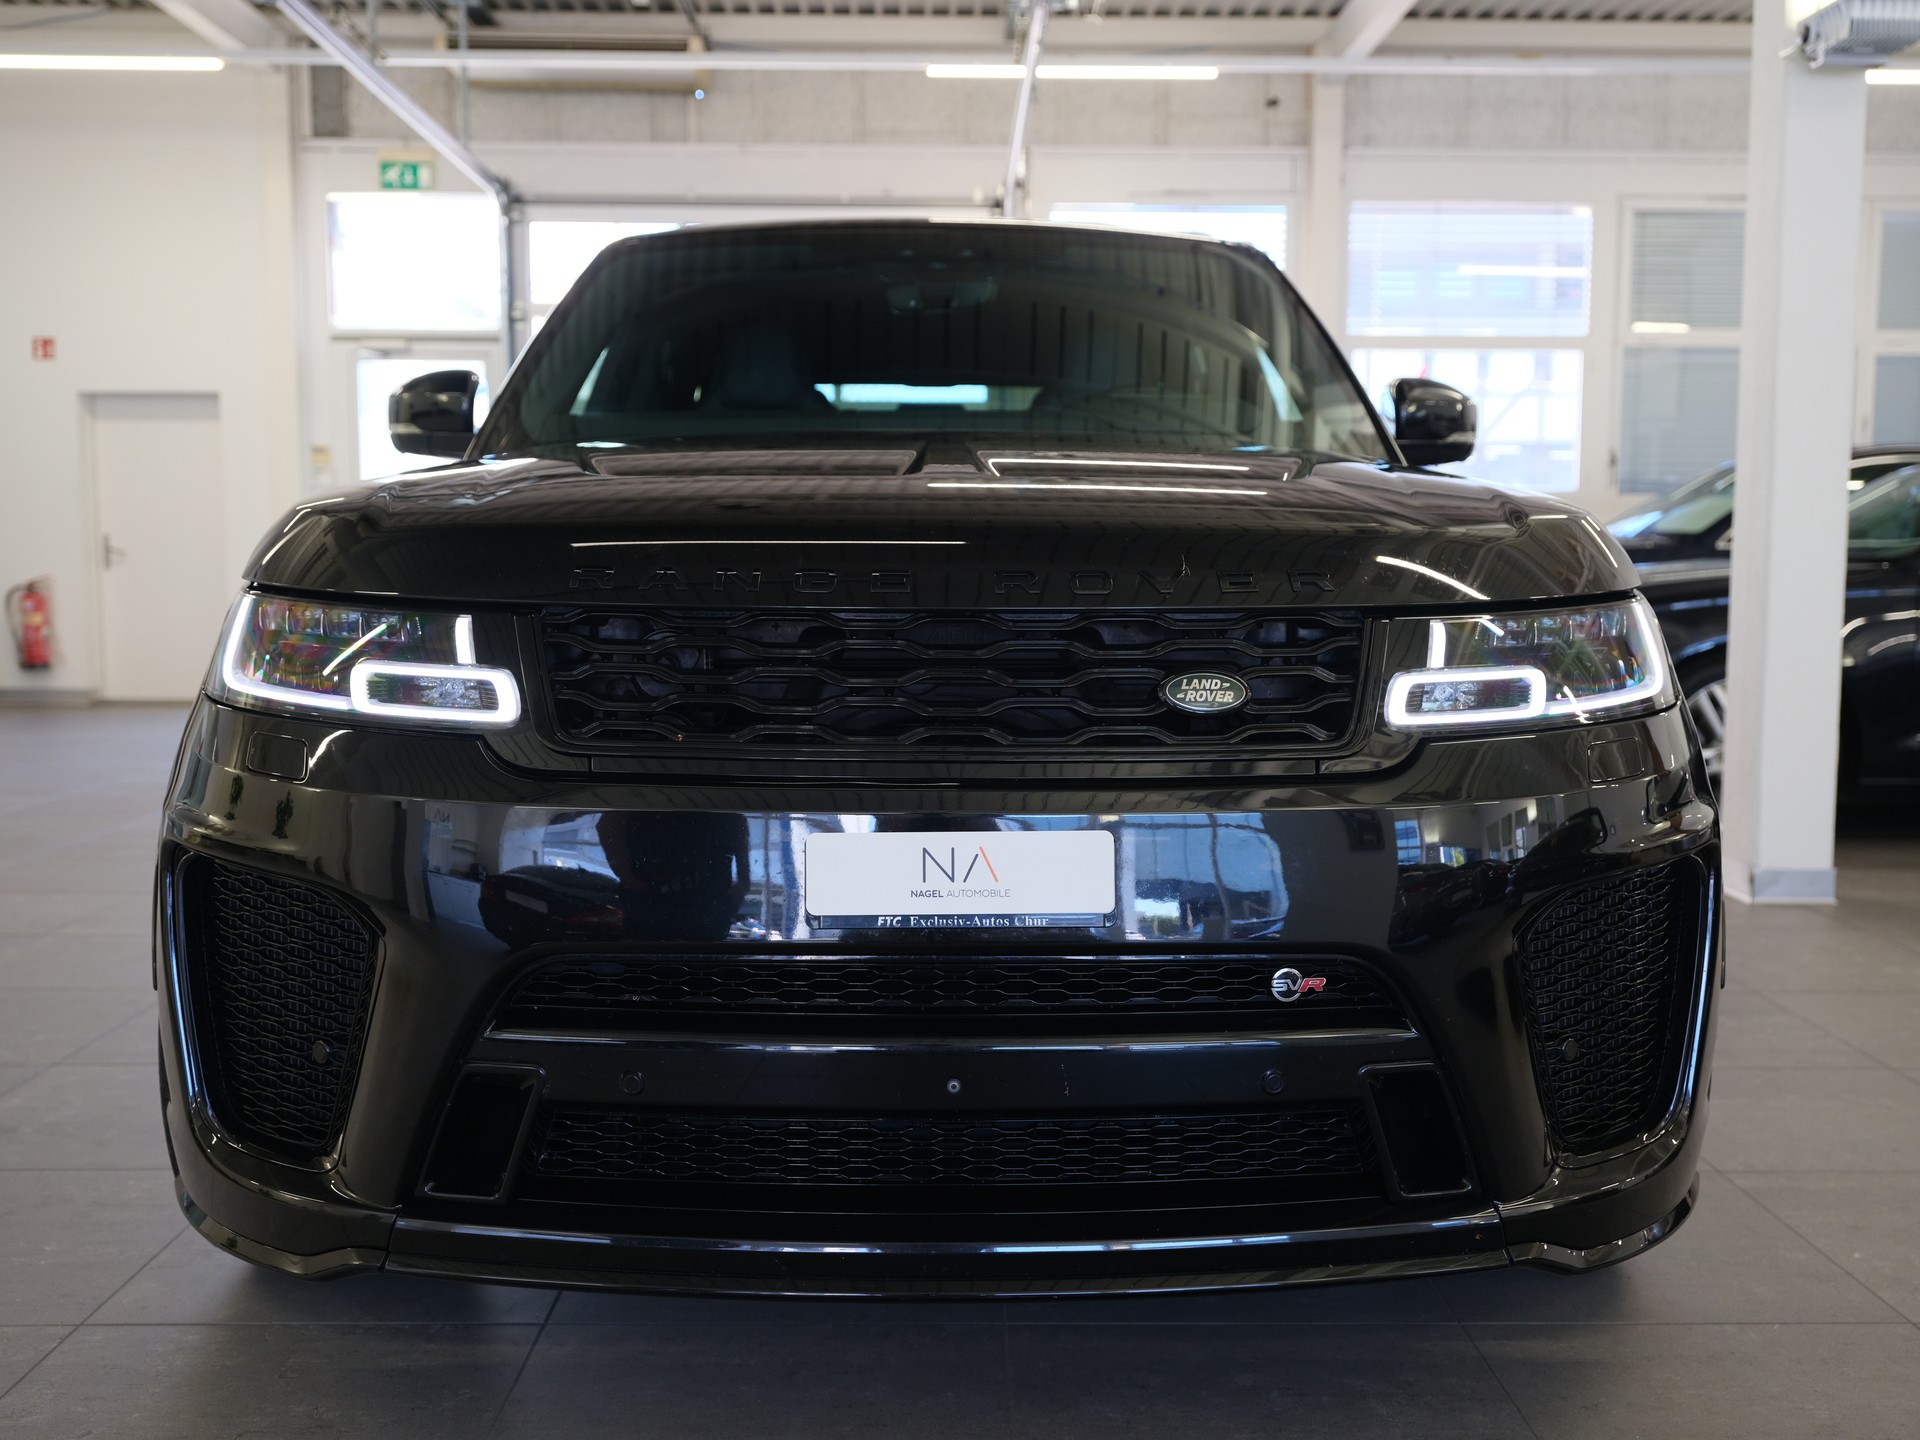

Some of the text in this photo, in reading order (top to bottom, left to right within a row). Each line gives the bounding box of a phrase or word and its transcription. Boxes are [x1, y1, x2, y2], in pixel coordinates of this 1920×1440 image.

[568, 566, 1335, 595] RANGE ROVER
[1181, 678, 1221, 690] LAND
[1185, 690, 1234, 703] ROVER
[910, 888, 1011, 898] NAGEL AUTOMOBILE
[877, 915, 1049, 928] FTC Exclusiv-Autos Chur
[1271, 977, 1326, 993] SVR
